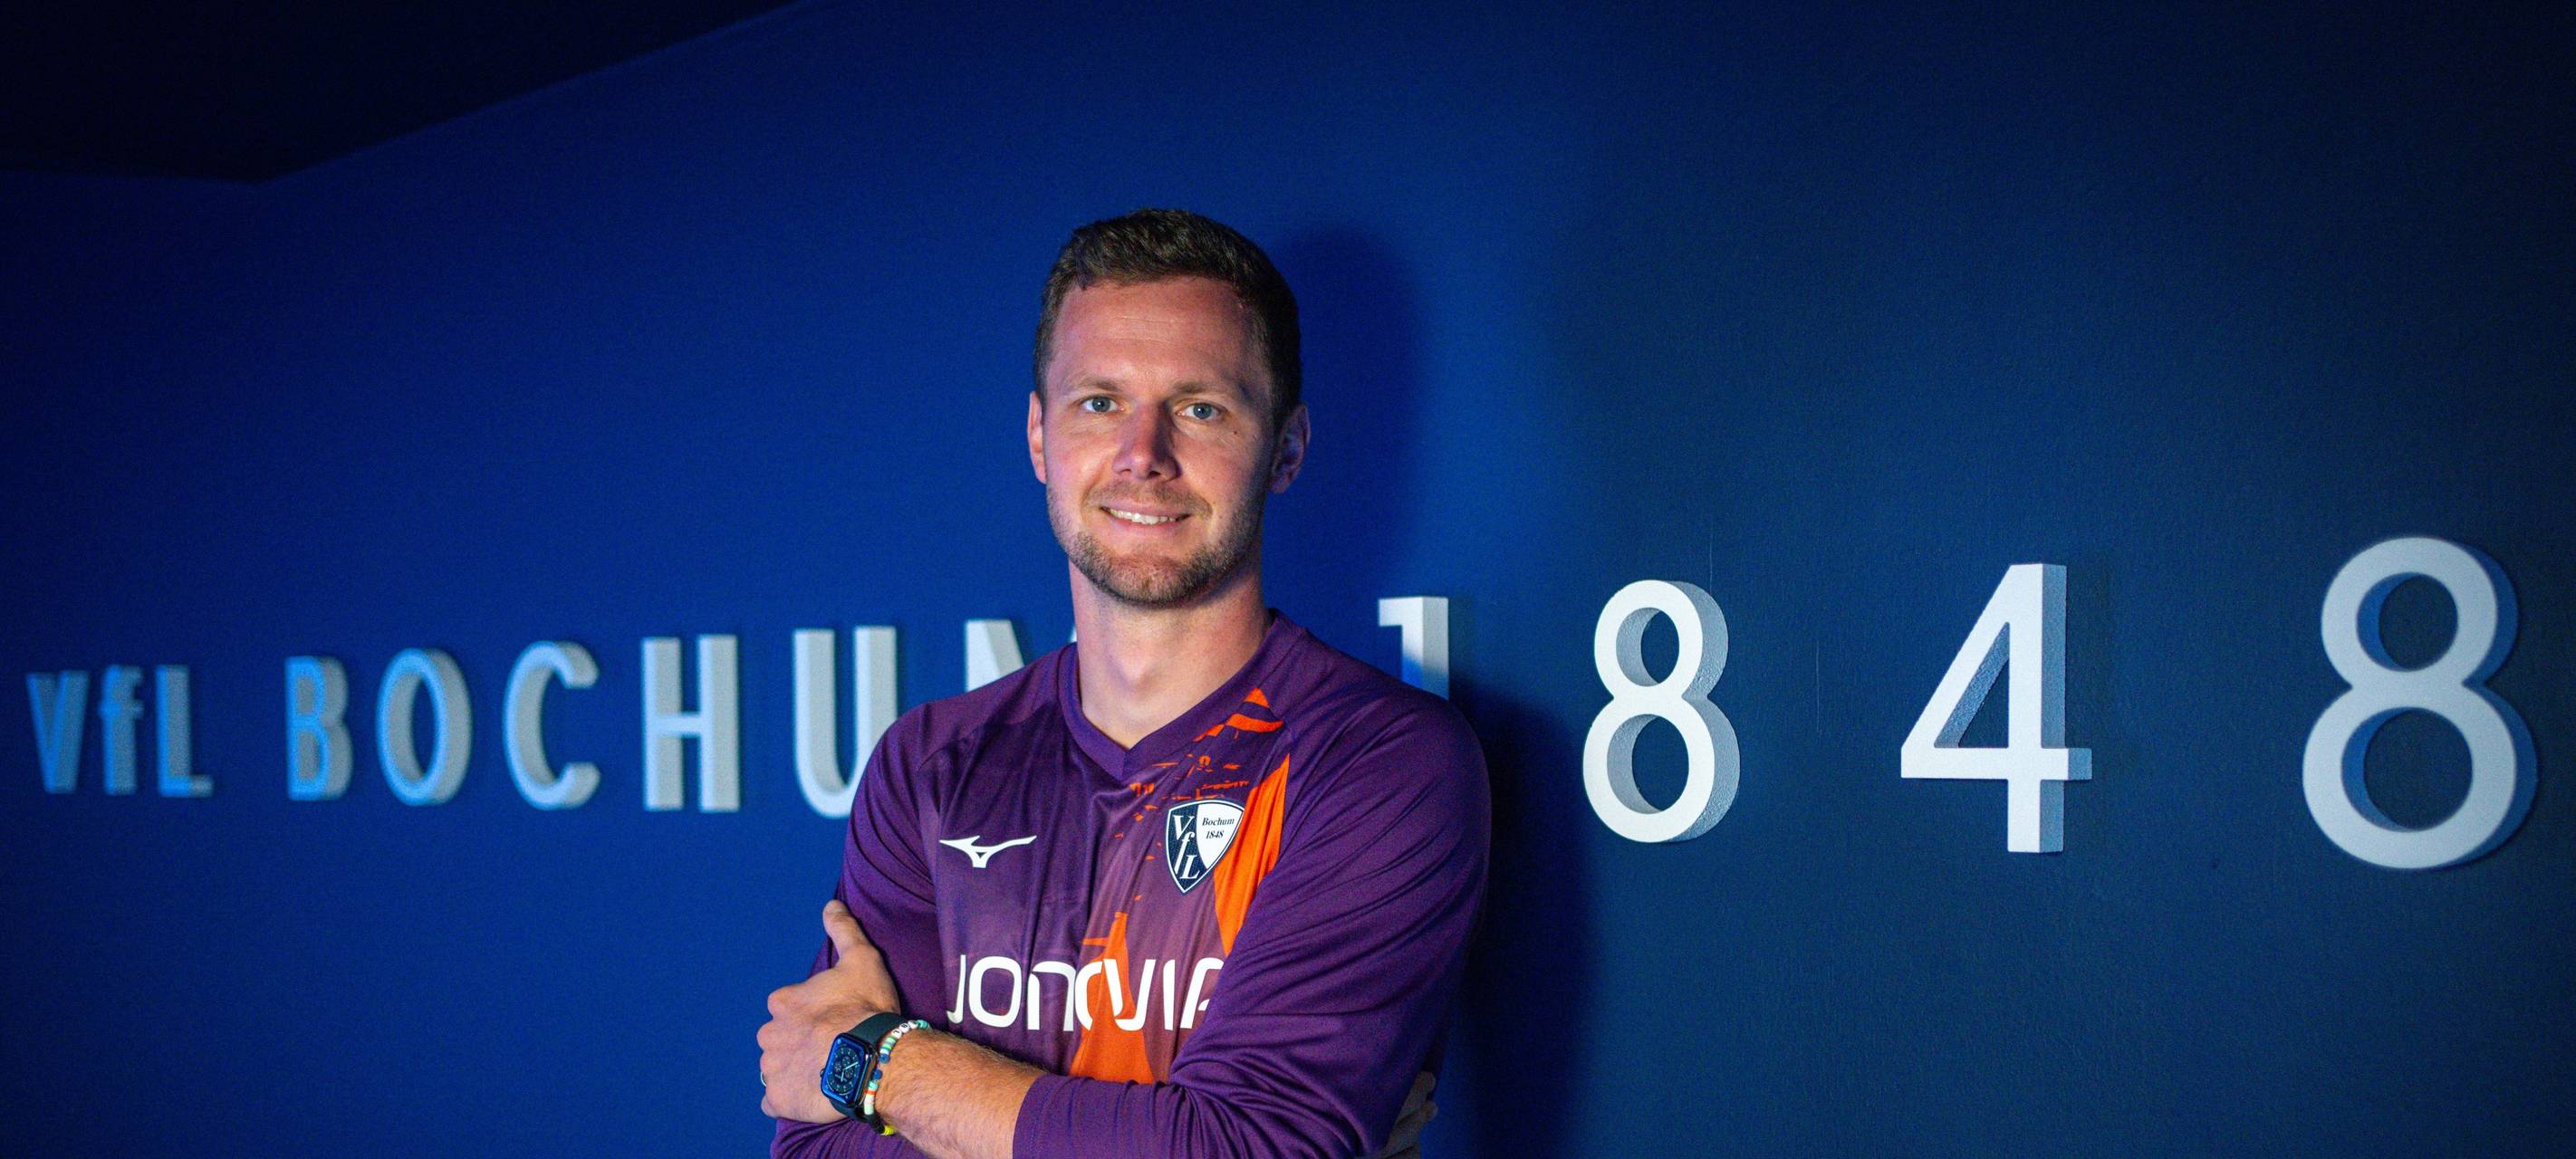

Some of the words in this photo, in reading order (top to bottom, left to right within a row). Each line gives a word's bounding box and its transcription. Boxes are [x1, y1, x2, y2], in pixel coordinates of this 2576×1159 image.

[25, 665, 213, 798] VfL
[1202, 817, 1235, 826] Bochum
[1206, 829, 1225, 839] 1848
